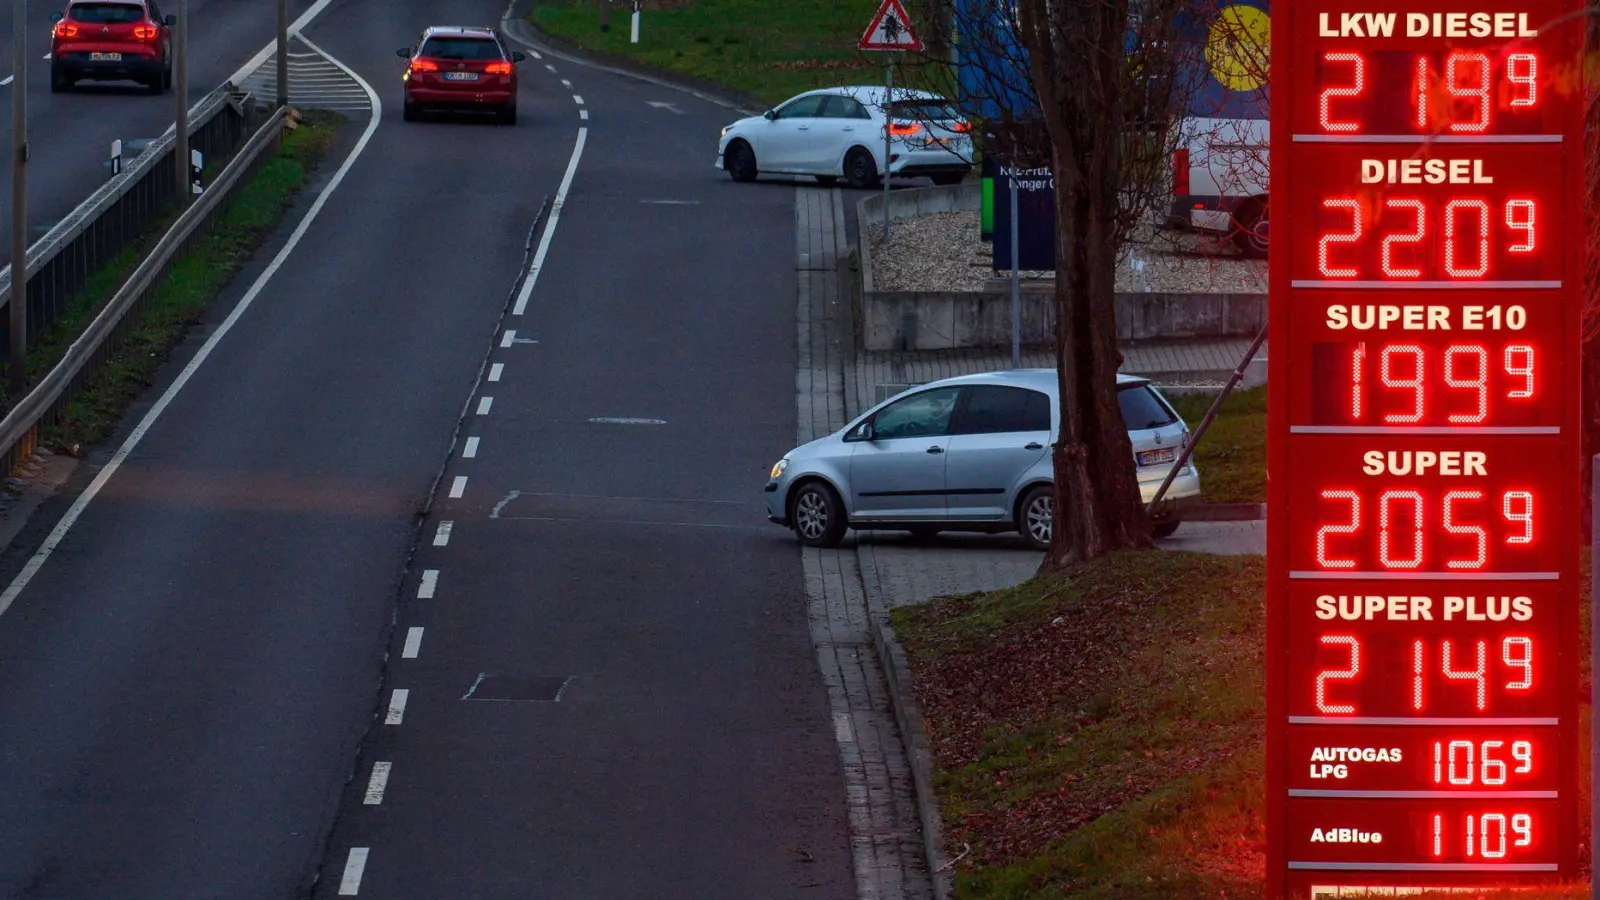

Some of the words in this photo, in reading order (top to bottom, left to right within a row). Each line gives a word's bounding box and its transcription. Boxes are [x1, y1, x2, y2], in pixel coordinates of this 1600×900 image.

[1319, 12, 1397, 38] LKW
[1406, 12, 1538, 38] DIESEL
[1361, 159, 1493, 184] DIESEL
[1326, 304, 1451, 330] SUPER
[1462, 304, 1526, 330] E10
[1362, 450, 1488, 476] SUPER
[1315, 595, 1433, 621] SUPER
[1443, 595, 1533, 621] PLUS
[1310, 747, 1402, 763] AUTOGAS
[1310, 764, 1348, 779] LPG
[1310, 828, 1382, 844] AdBlue
